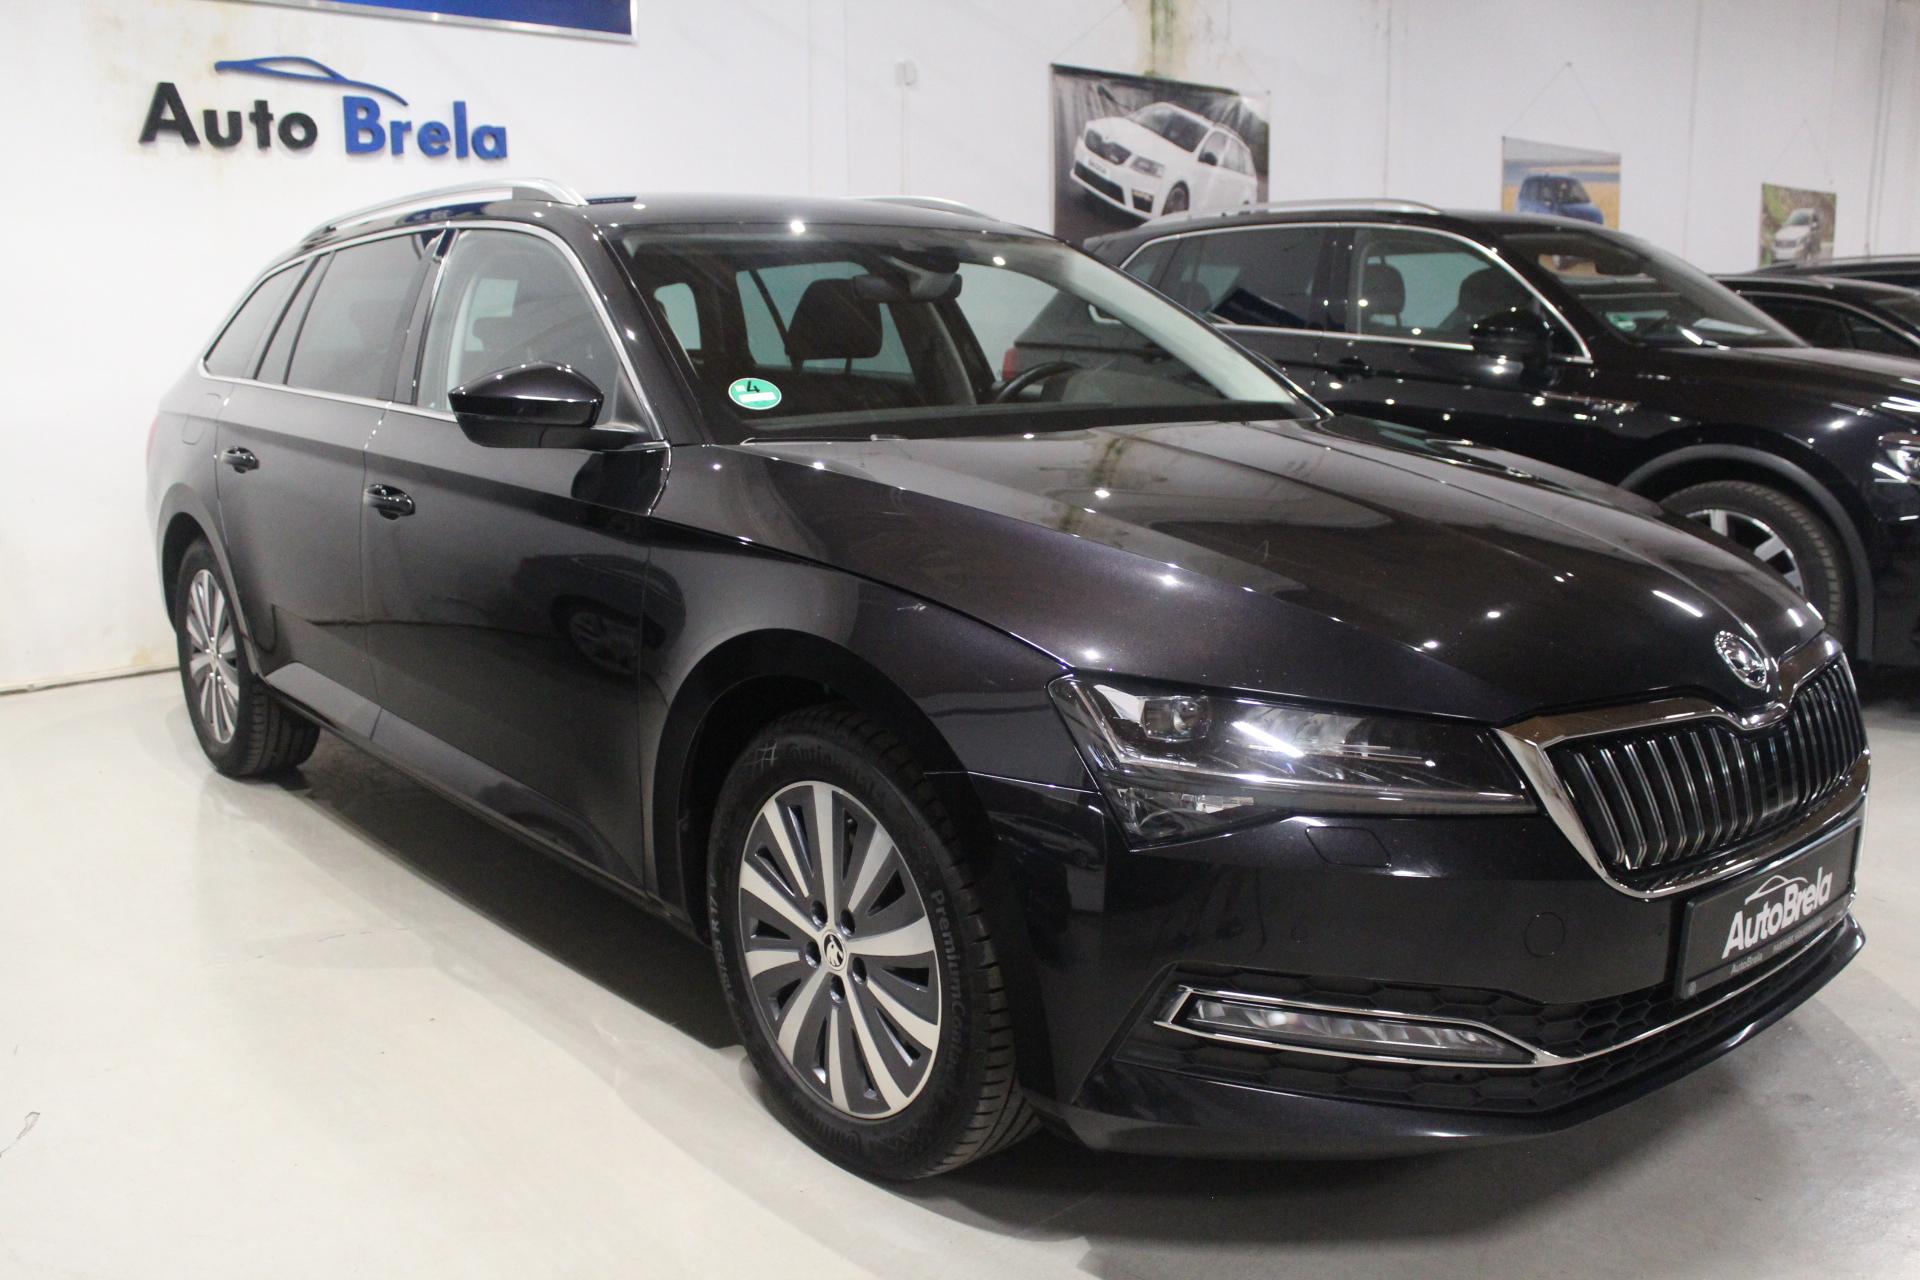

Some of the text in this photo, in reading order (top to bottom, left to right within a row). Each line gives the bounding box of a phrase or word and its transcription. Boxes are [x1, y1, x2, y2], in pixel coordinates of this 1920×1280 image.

[139, 82, 508, 160] Auto Brela
[746, 380, 761, 393] 4
[1722, 866, 1833, 959] AutoBrela
